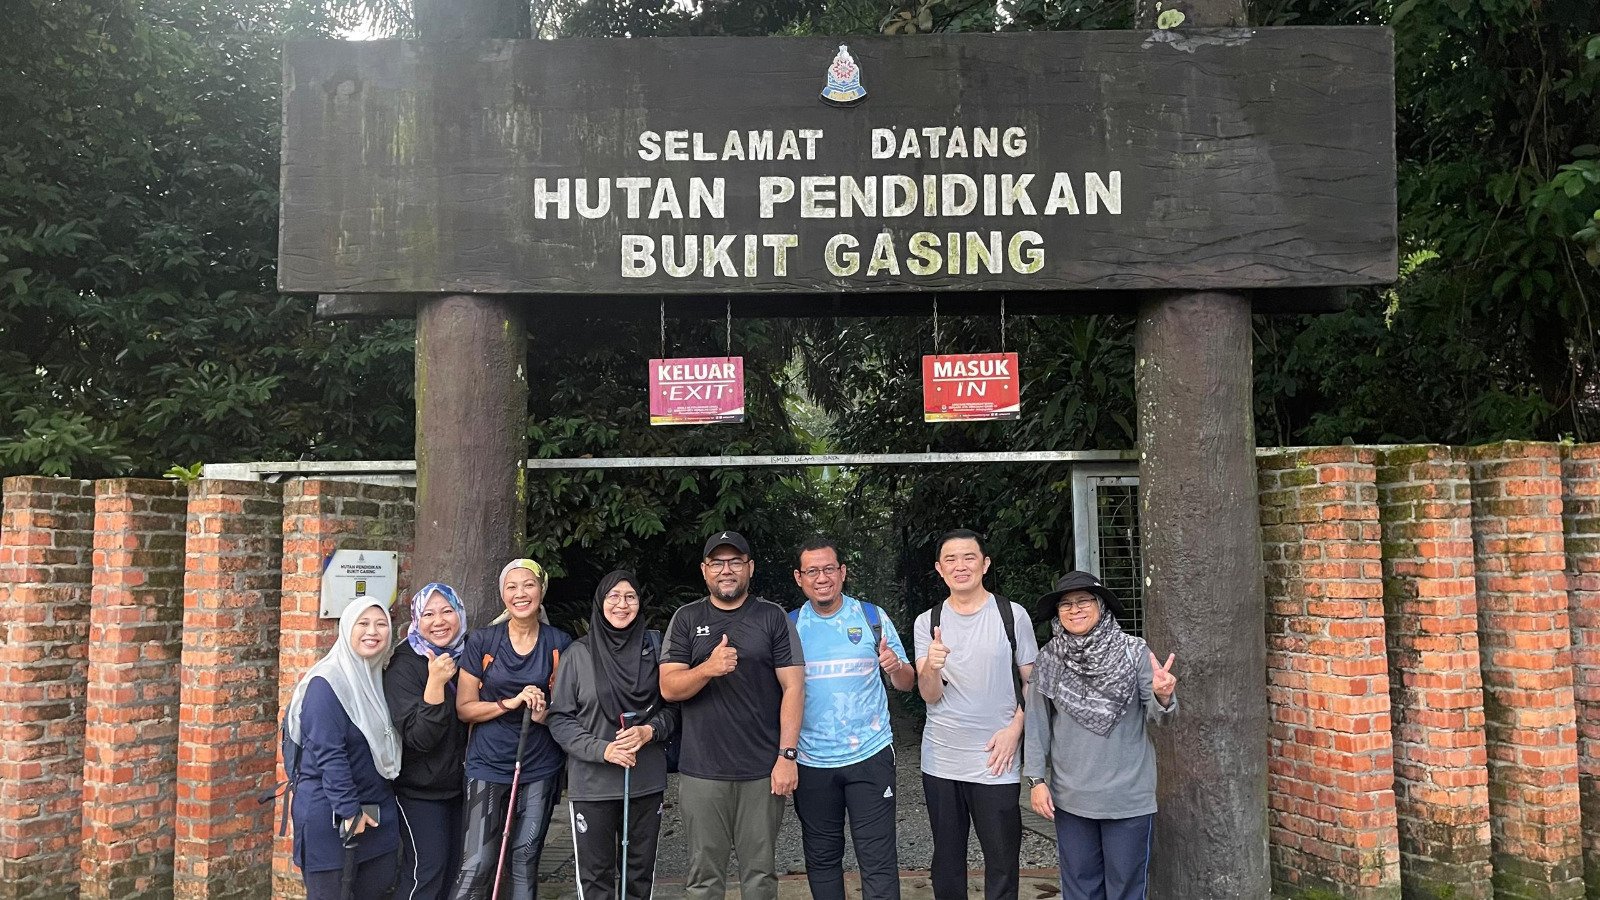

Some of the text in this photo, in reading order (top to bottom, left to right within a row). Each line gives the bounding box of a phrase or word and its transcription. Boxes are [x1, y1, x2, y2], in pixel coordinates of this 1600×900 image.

[638, 126, 1027, 162] SELAMAT DATANG
[533, 171, 1122, 220] HUTAN PENDIDIKAN
[620, 230, 1045, 279] BUKIT GASING
[658, 363, 736, 381] KELUAR
[933, 359, 1010, 378] MASUK
[669, 384, 729, 401] EXIT
[957, 381, 987, 397] IN
